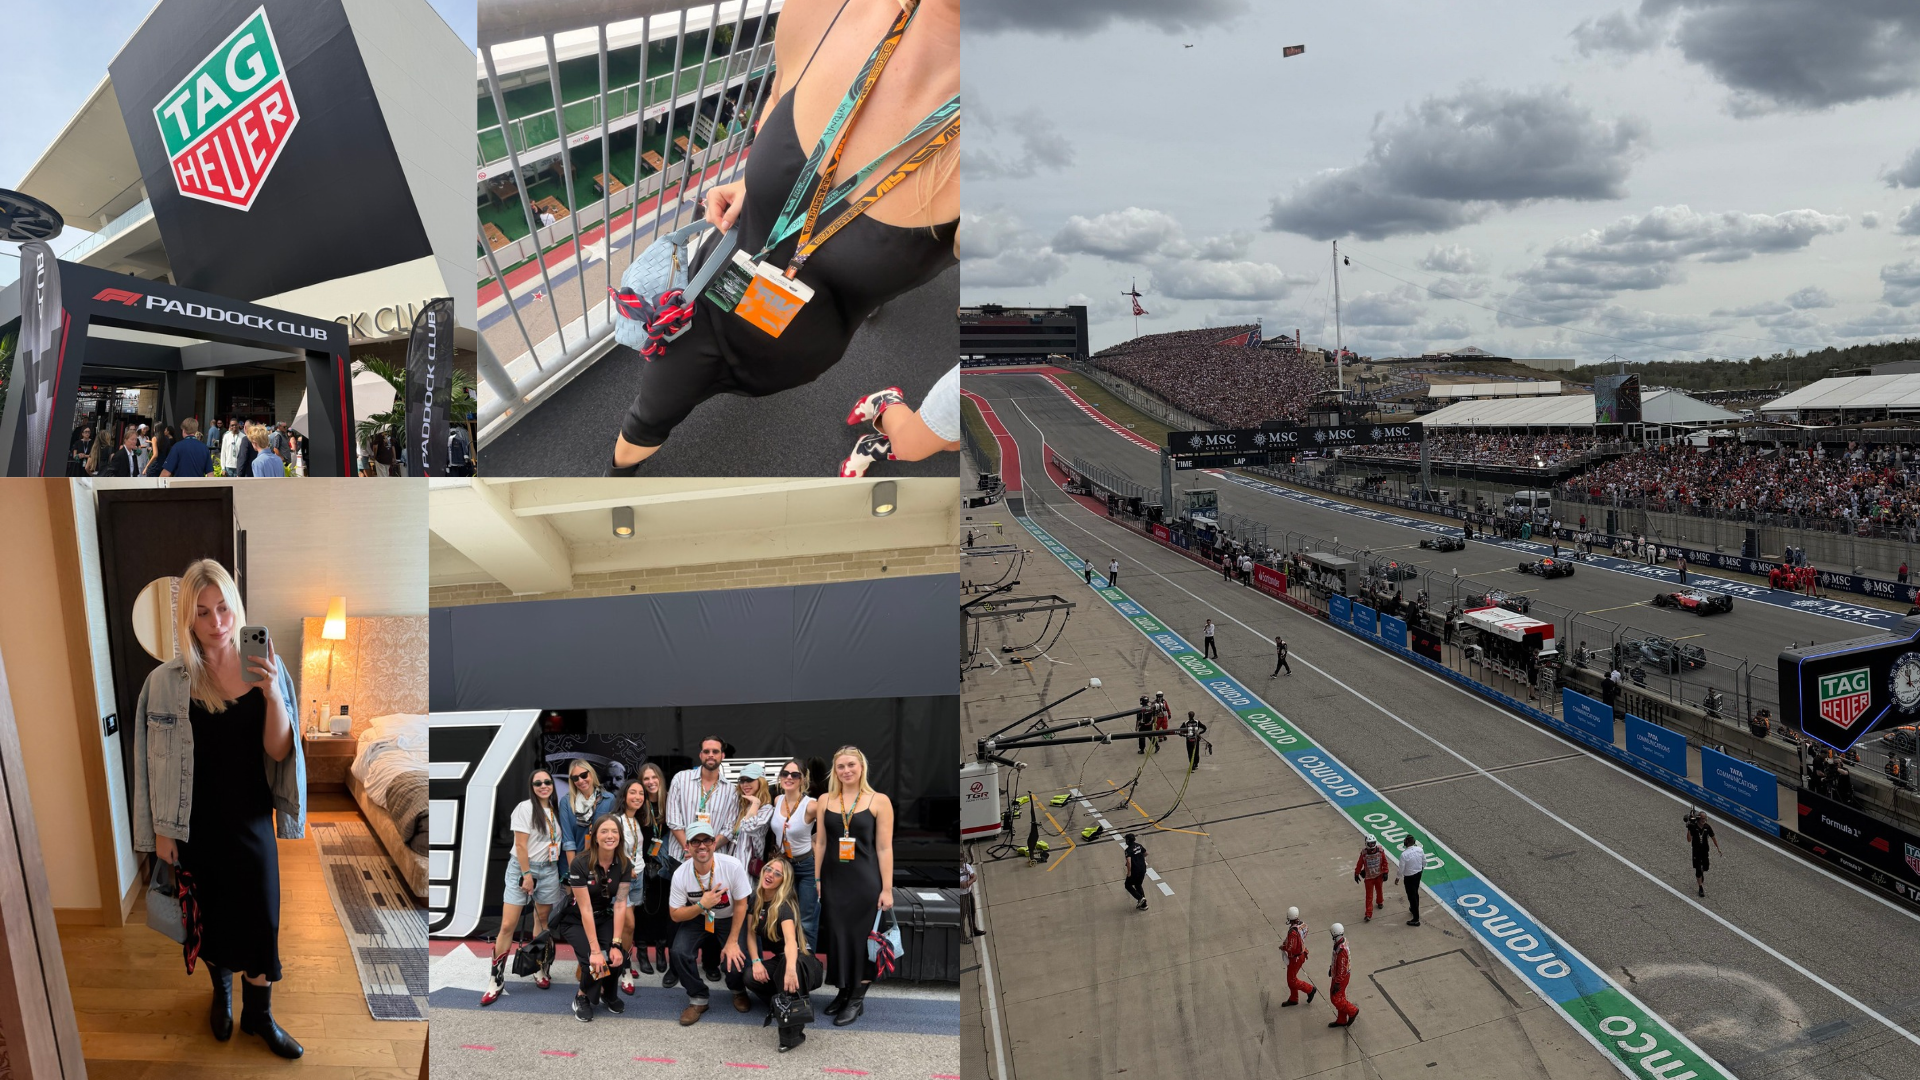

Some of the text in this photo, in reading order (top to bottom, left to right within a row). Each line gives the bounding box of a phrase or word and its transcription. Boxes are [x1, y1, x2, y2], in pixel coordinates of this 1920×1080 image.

[163, 32, 267, 141] TAG
[178, 96, 288, 199] HEUER
[146, 295, 274, 331] PADDOCK
[277, 321, 328, 341] CLUB
[421, 311, 436, 468] PADDOCK CLUB
[1205, 434, 1236, 446] MSC
[1269, 432, 1298, 443] MSC
[1328, 429, 1356, 440] MSC
[1384, 427, 1410, 437] MSC
[1177, 460, 1193, 468] TIME
[1696, 552, 1710, 562] MSC
[1726, 557, 1741, 567] MSC
[1831, 574, 1851, 586] MSC
[1874, 581, 1895, 593] MSC
[1821, 604, 1891, 620] MSC
[1179, 655, 1213, 676] aramco
[1823, 673, 1866, 696] TAG
[1210, 681, 1251, 706] aramco
[1823, 695, 1868, 725] HEUER
[1247, 713, 1298, 745] aramco
[1647, 732, 1658, 742] TATA
[1636, 733, 1670, 753] COMMUNICATIONS
[1297, 755, 1359, 797] aramco
[1716, 768, 1758, 792] COMMUNICATIONS
[1729, 767, 1743, 778] TATA
[1821, 814, 1853, 835] Formula
[1908, 846, 1920, 857] TA
[1840, 858, 1857, 869] Formula
[1908, 887, 1920, 902] TA
[1456, 893, 1572, 979] aramco
